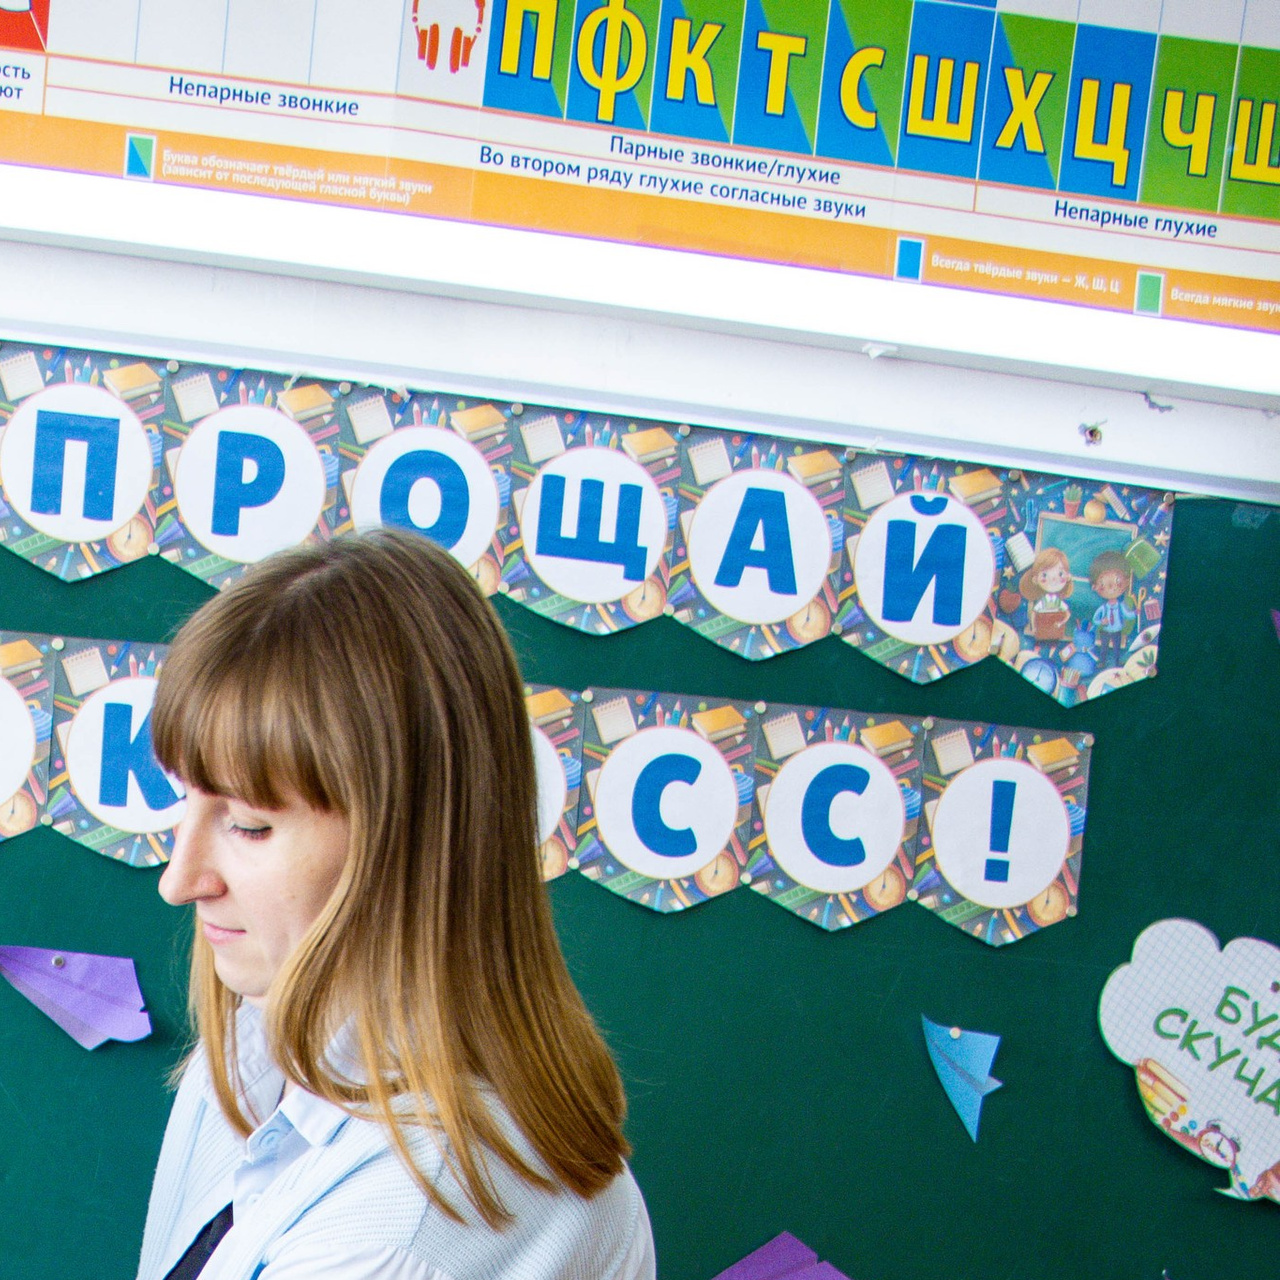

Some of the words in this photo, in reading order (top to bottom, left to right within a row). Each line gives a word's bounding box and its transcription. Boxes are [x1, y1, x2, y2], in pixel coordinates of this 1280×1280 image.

[169, 76, 271, 105] Непарные
[278, 94, 359, 116] звонкие
[665, 16, 726, 107] К
[756, 30, 807, 118] Т
[839, 46, 886, 131] С
[905, 54, 980, 144] Ш
[993, 66, 1056, 155] Х
[1072, 78, 1132, 188] Ц
[1162, 89, 1217, 177] Ч
[163, 149, 199, 165] Буква
[202, 155, 270, 174] обозначает
[273, 163, 325, 182] твёрдый
[327, 172, 350, 183] или
[353, 175, 396, 190] мягкий
[400, 180, 433, 195] звуки
[163, 163, 213, 180] (зависит
[232, 172, 317, 193] последующей
[319, 184, 366, 199] гласной
[610, 136, 684, 165] Парные
[690, 152, 841, 185] звонкие/глухие
[479, 146, 504, 167] Во
[511, 154, 581, 179] втором
[587, 164, 633, 189] ряду
[639, 173, 704, 197] глухие
[710, 181, 808, 209] согласные
[814, 197, 867, 219] звуки
[1054, 199, 1149, 231] Непарные
[1154, 216, 1218, 240] глухие
[931, 254, 970, 272] Всегда
[973, 260, 1022, 279] твёрдые
[1026, 269, 1058, 285] звуки
[1171, 287, 1210, 305] Всегда
[1212, 295, 1253, 310] мягкие
[30, 408, 966, 627] ПРОЩАЙ
